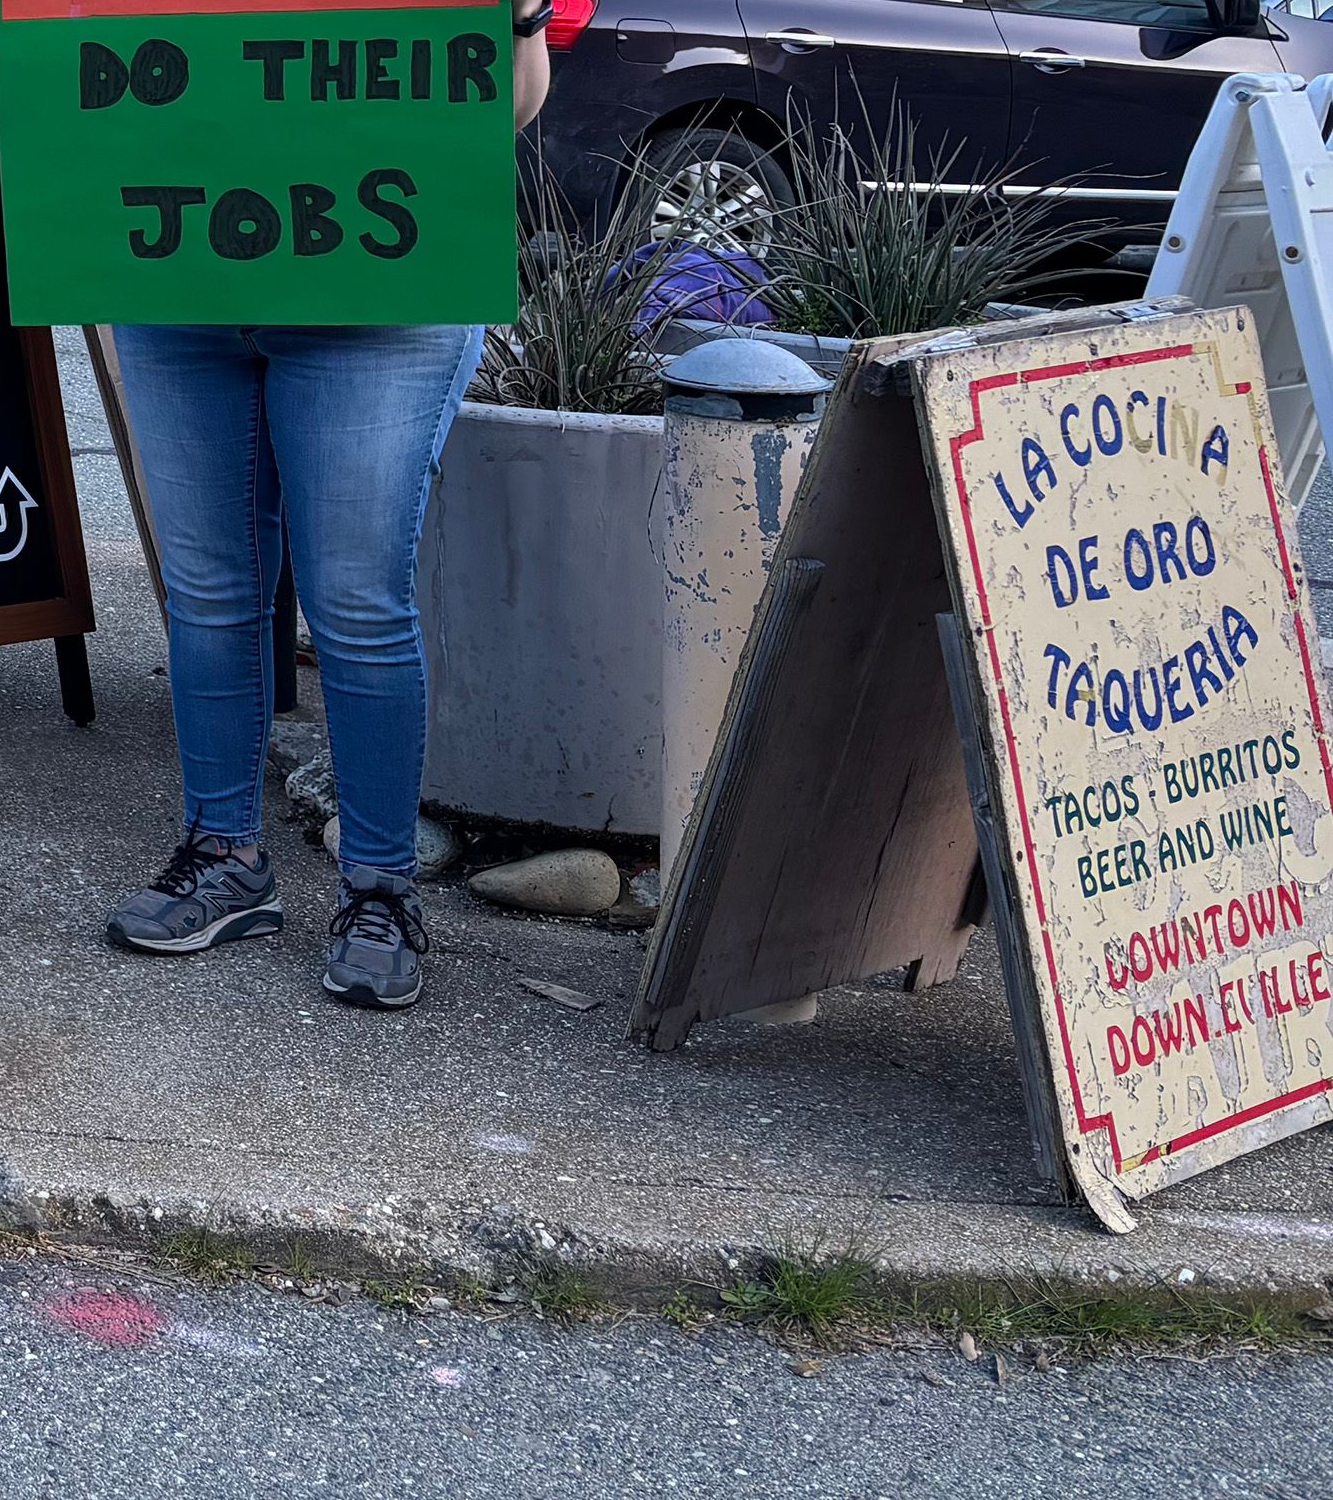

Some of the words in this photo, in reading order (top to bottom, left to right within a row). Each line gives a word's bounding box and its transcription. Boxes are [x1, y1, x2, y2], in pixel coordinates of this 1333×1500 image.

[79, 38, 190, 111] DO
[243, 32, 499, 103] THEIR
[120, 168, 420, 261] JOBS
[993, 437, 1058, 529] LA
[1046, 535, 1110, 609] DE
[1123, 515, 1216, 591] ORO
[1043, 605, 1259, 736] TAQUERIA
[1044, 775, 1140, 838] TACOS
[1163, 730, 1301, 804] BURRITOS
[1077, 839, 1152, 899] BEER
[1158, 820, 1215, 873] AND
[1220, 796, 1294, 851] WINE
[1107, 952, 1331, 1076] DOWNEILLE
